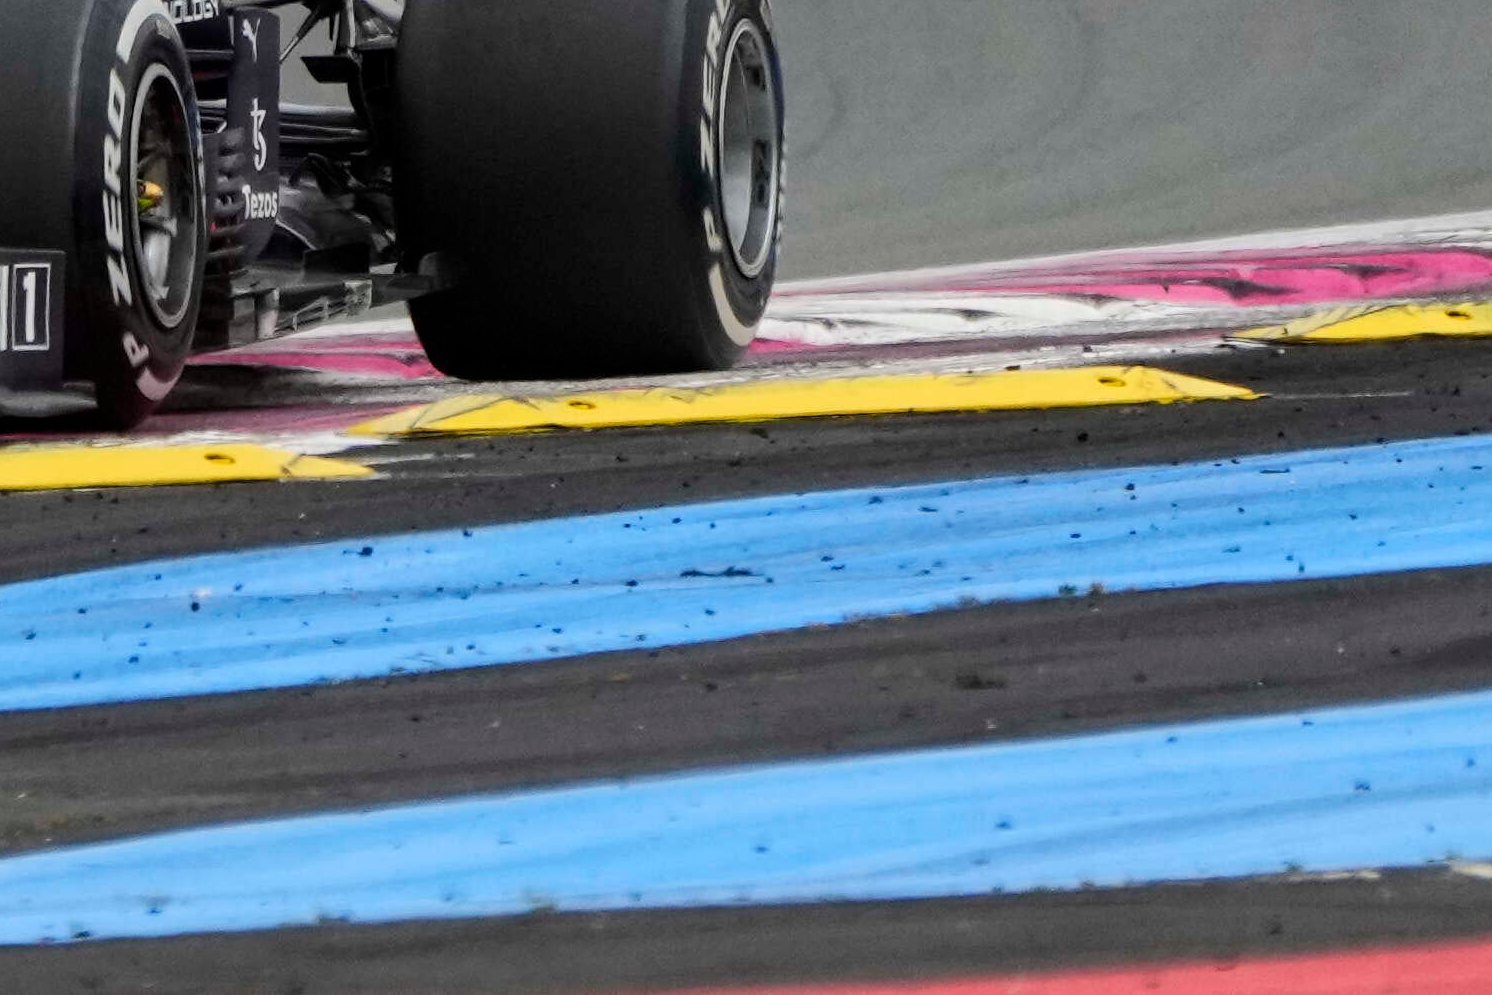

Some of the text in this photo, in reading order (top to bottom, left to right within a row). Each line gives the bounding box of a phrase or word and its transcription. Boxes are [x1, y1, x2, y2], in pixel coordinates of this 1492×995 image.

[103, 68, 150, 366] P ZERO
[241, 184, 278, 220] Tezos
